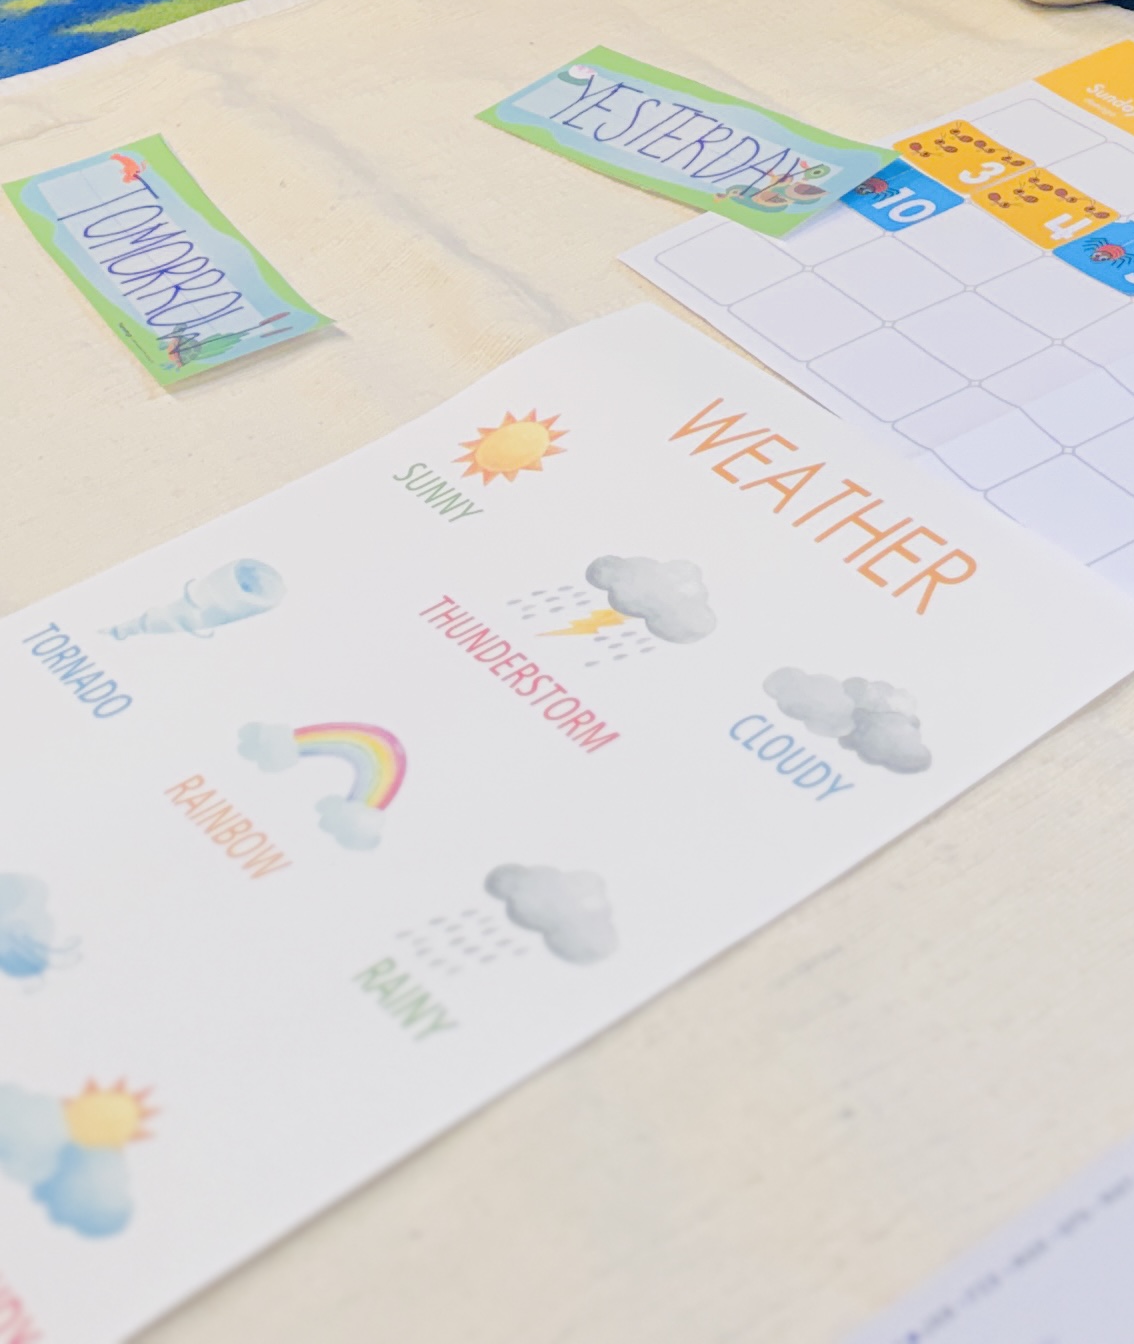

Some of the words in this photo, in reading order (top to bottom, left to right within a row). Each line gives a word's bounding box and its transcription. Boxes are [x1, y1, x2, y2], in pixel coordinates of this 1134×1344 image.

[549, 74, 825, 198] YESTERDAY
[958, 156, 1006, 187] 3
[871, 186, 938, 225] 10
[1044, 213, 1094, 242] 4
[57, 174, 258, 355] TOMORROW
[391, 461, 485, 524] SUNNY
[666, 396, 978, 616] WEATHER
[21, 622, 134, 719] TORNADO
[417, 594, 621, 755] THUNDERSTORM
[727, 712, 856, 803] CLOUDY
[163, 773, 294, 881] RAINBOW
[351, 956, 457, 1044] RAINY
